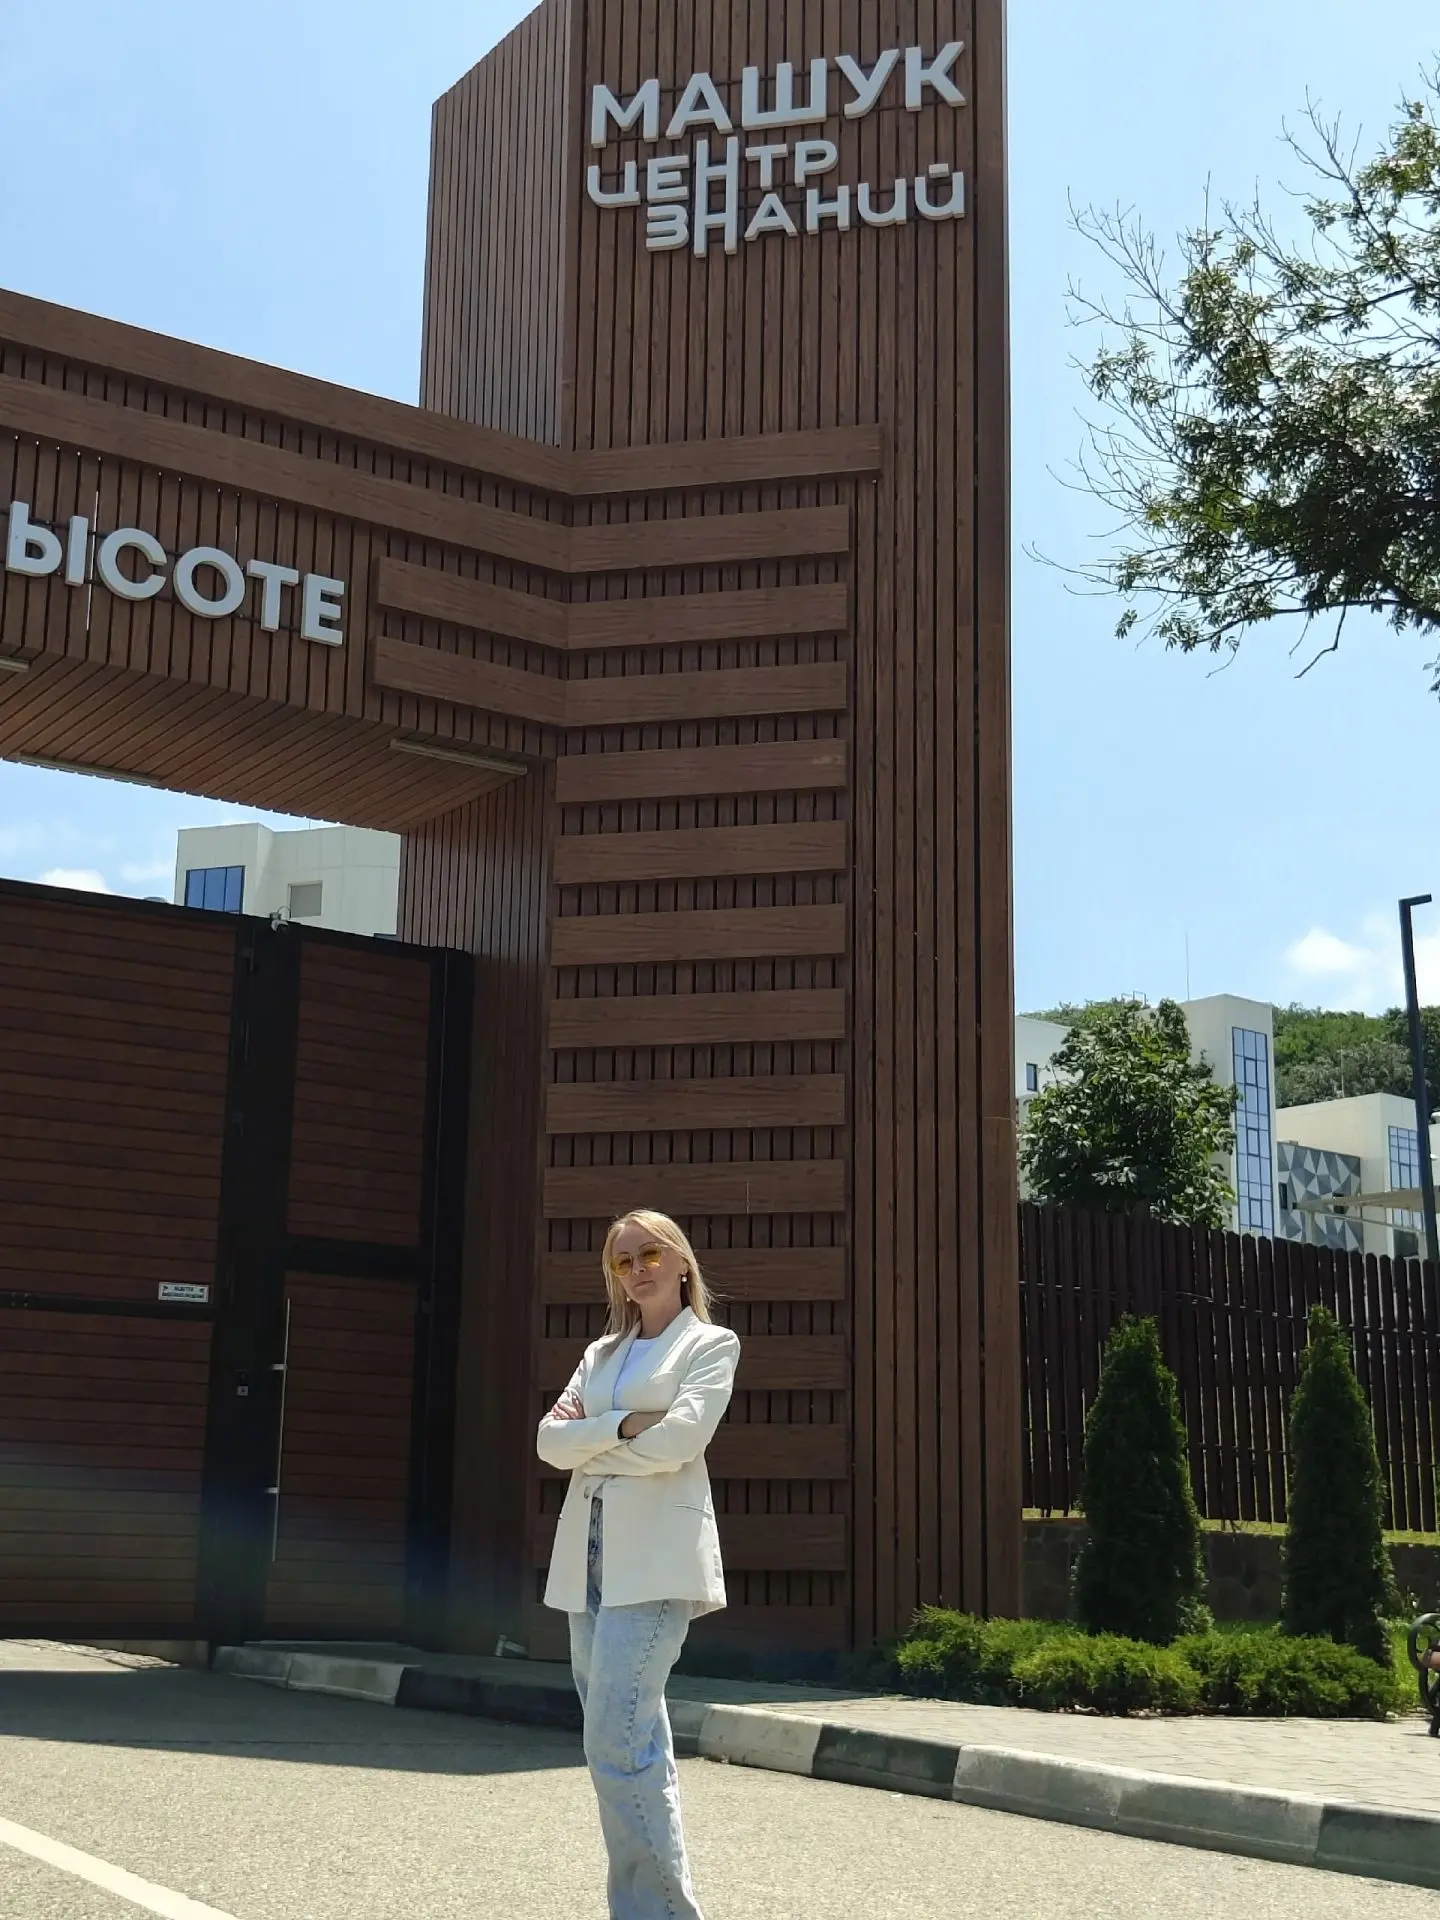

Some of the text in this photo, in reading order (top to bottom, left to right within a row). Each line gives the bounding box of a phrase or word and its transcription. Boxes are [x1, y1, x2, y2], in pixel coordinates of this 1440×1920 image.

[591, 41, 967, 148] МАШУК
[587, 136, 839, 258] ЦЕНТР
[645, 163, 966, 258] ЗНАНИЙ
[6, 501, 345, 647] ЫСОТЕ
